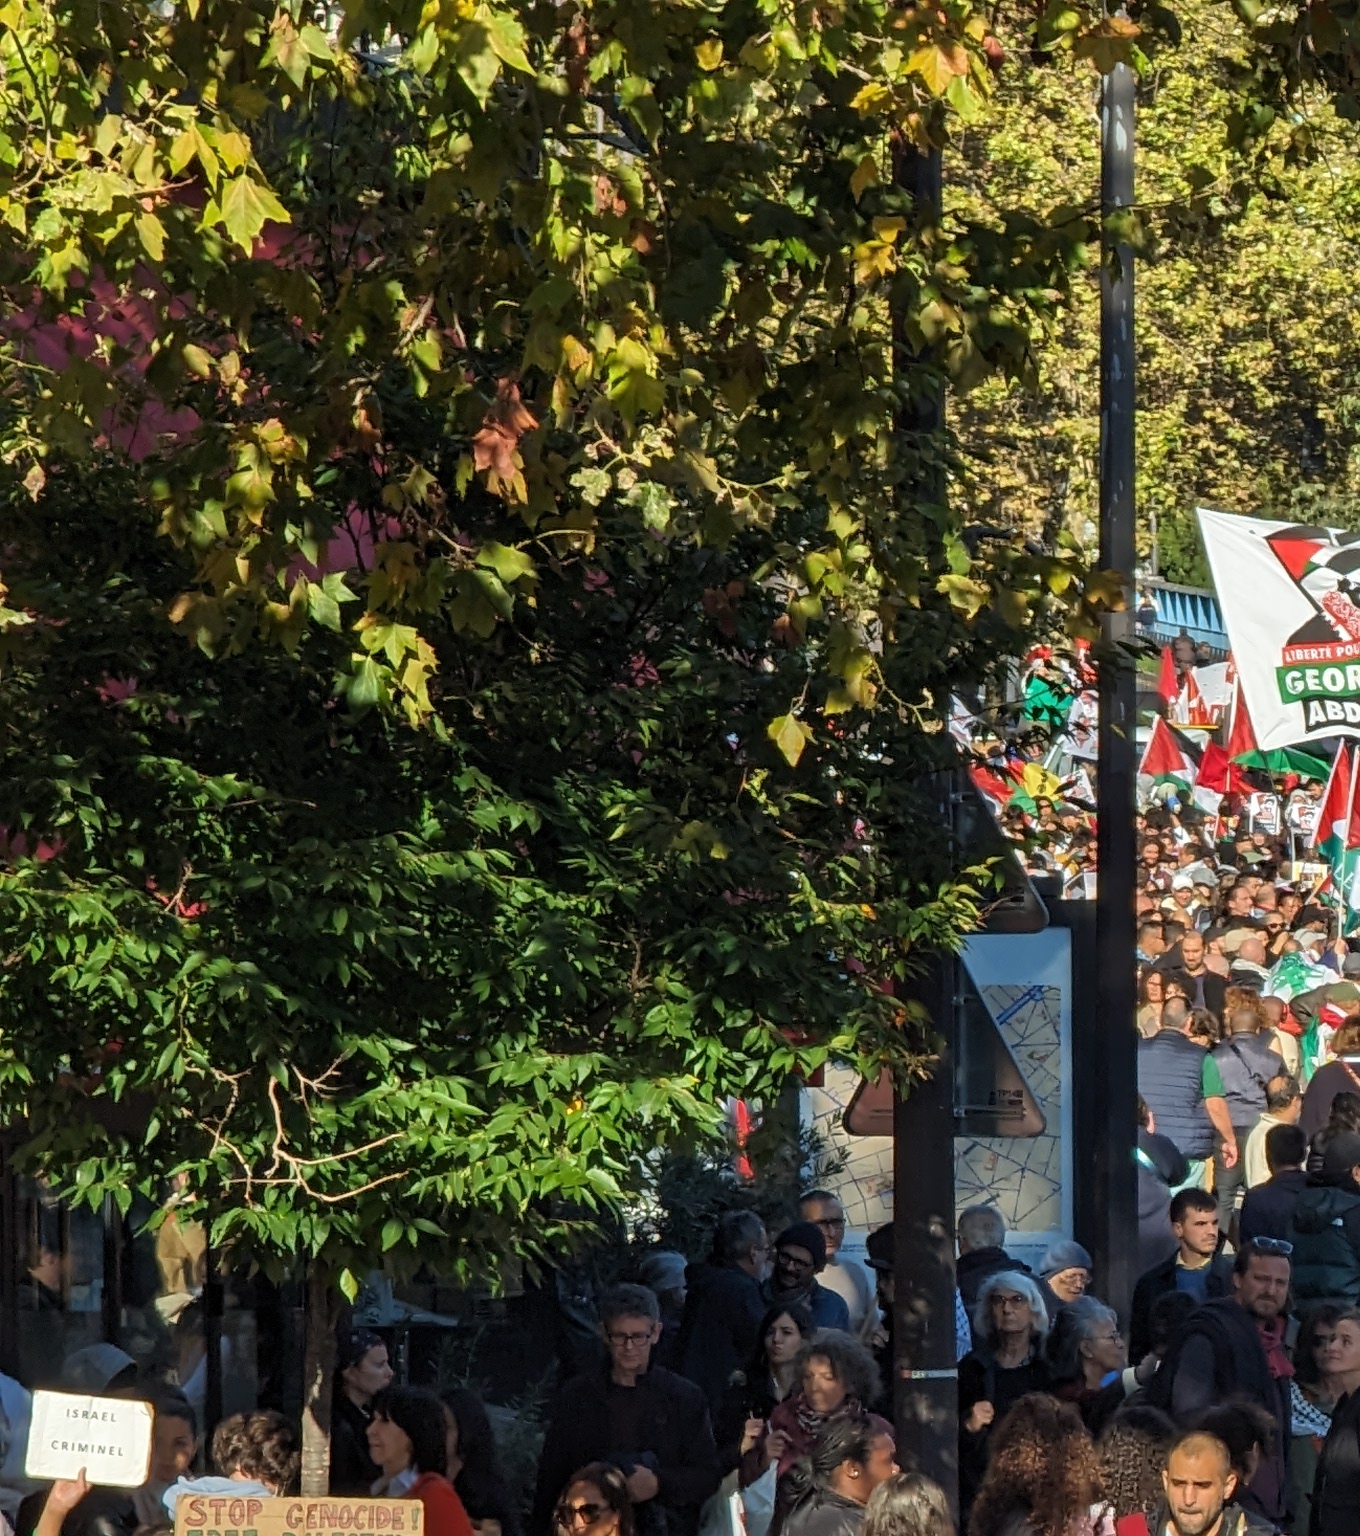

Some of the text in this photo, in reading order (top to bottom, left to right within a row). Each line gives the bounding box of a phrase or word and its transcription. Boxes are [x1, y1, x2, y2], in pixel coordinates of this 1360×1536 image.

[66, 1408, 117, 1422] ISRAEL
[51, 1440, 124, 1456] CRIMINEL
[184, 1498, 263, 1527] STOP
